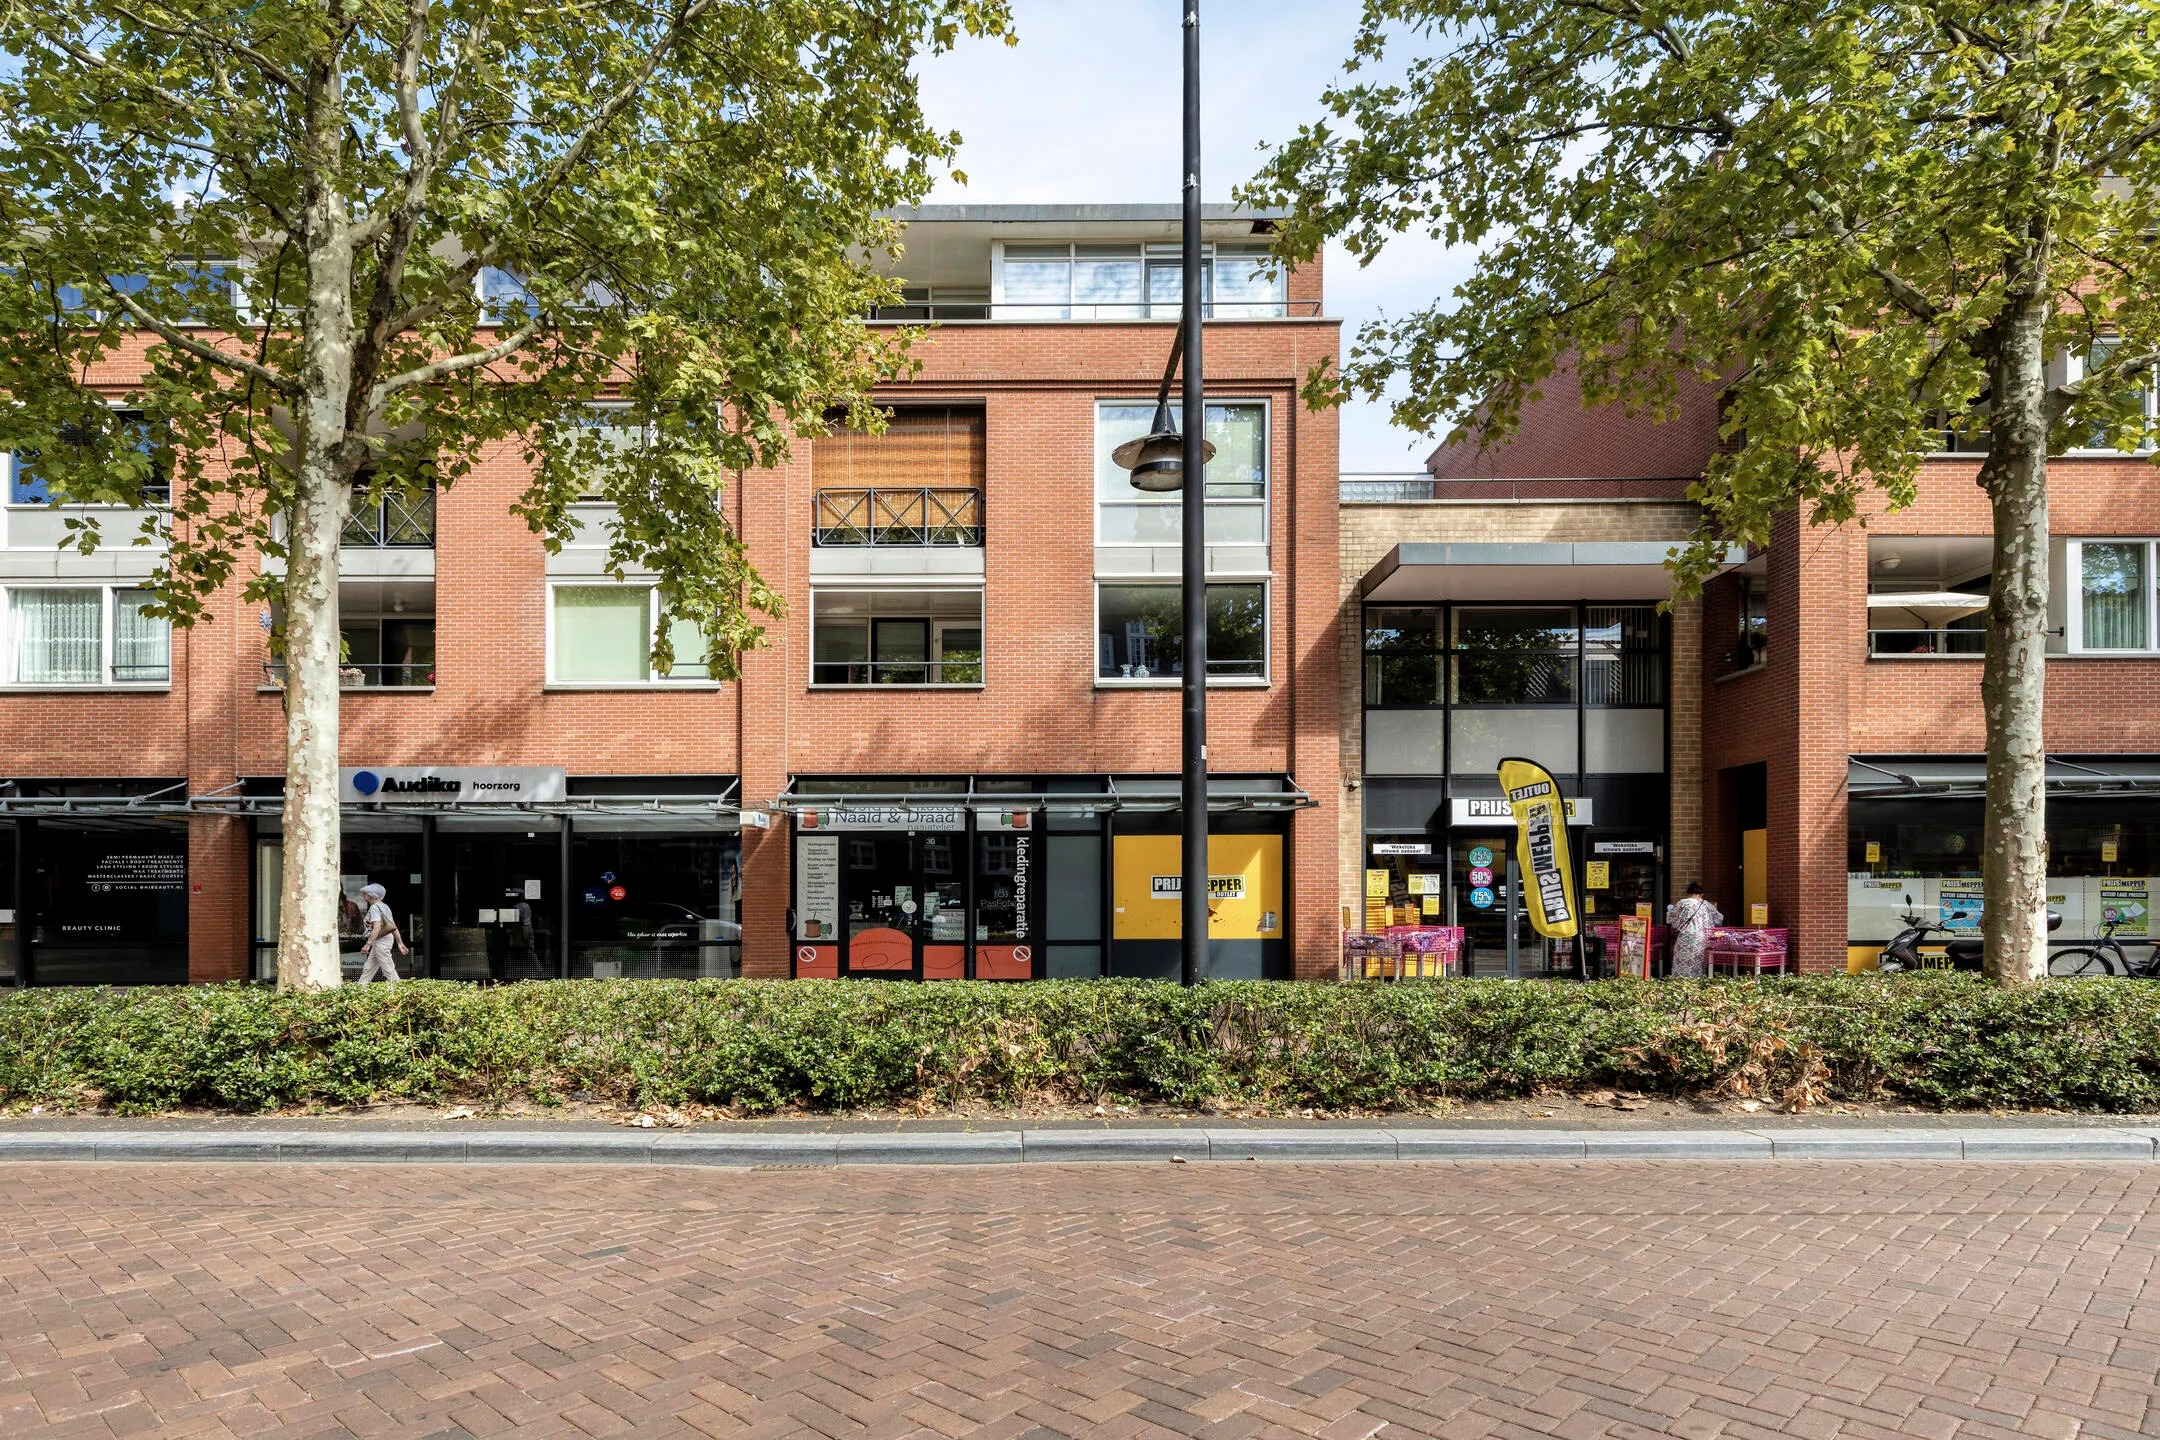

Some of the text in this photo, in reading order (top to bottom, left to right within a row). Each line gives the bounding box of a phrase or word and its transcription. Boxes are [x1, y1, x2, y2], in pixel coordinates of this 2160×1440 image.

[381, 776, 520, 792] Audika hoorzorg
[835, 809, 955, 823] Naald & Draad
[1472, 851, 1490, 860] 25%
[1472, 871, 1490, 880] 50%
[1013, 837, 1030, 939] kledingreparatie
[1474, 892, 1491, 900] 75%
